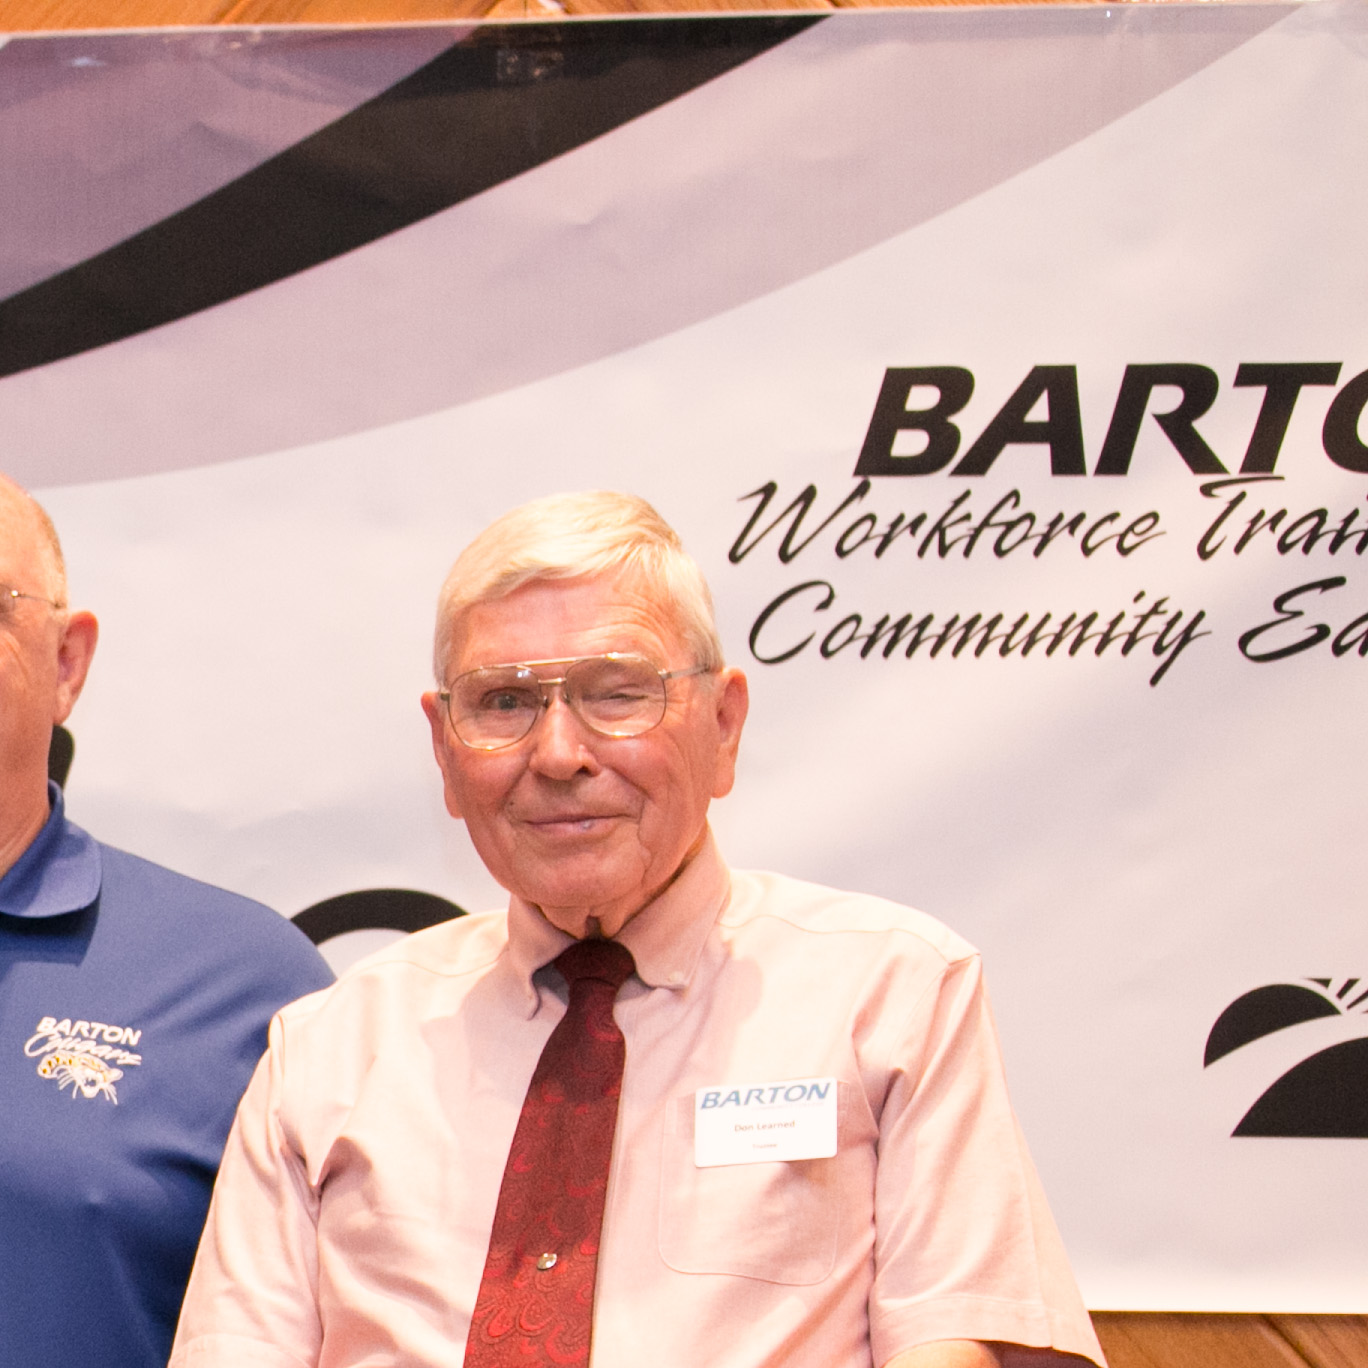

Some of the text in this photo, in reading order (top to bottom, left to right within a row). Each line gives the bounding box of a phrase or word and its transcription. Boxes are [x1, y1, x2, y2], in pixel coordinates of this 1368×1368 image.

[728, 478, 1167, 565] Workforce
[748, 580, 1212, 687] Community
[36, 1016, 142, 1046] BARTON
[701, 1083, 830, 1109] BARTON
